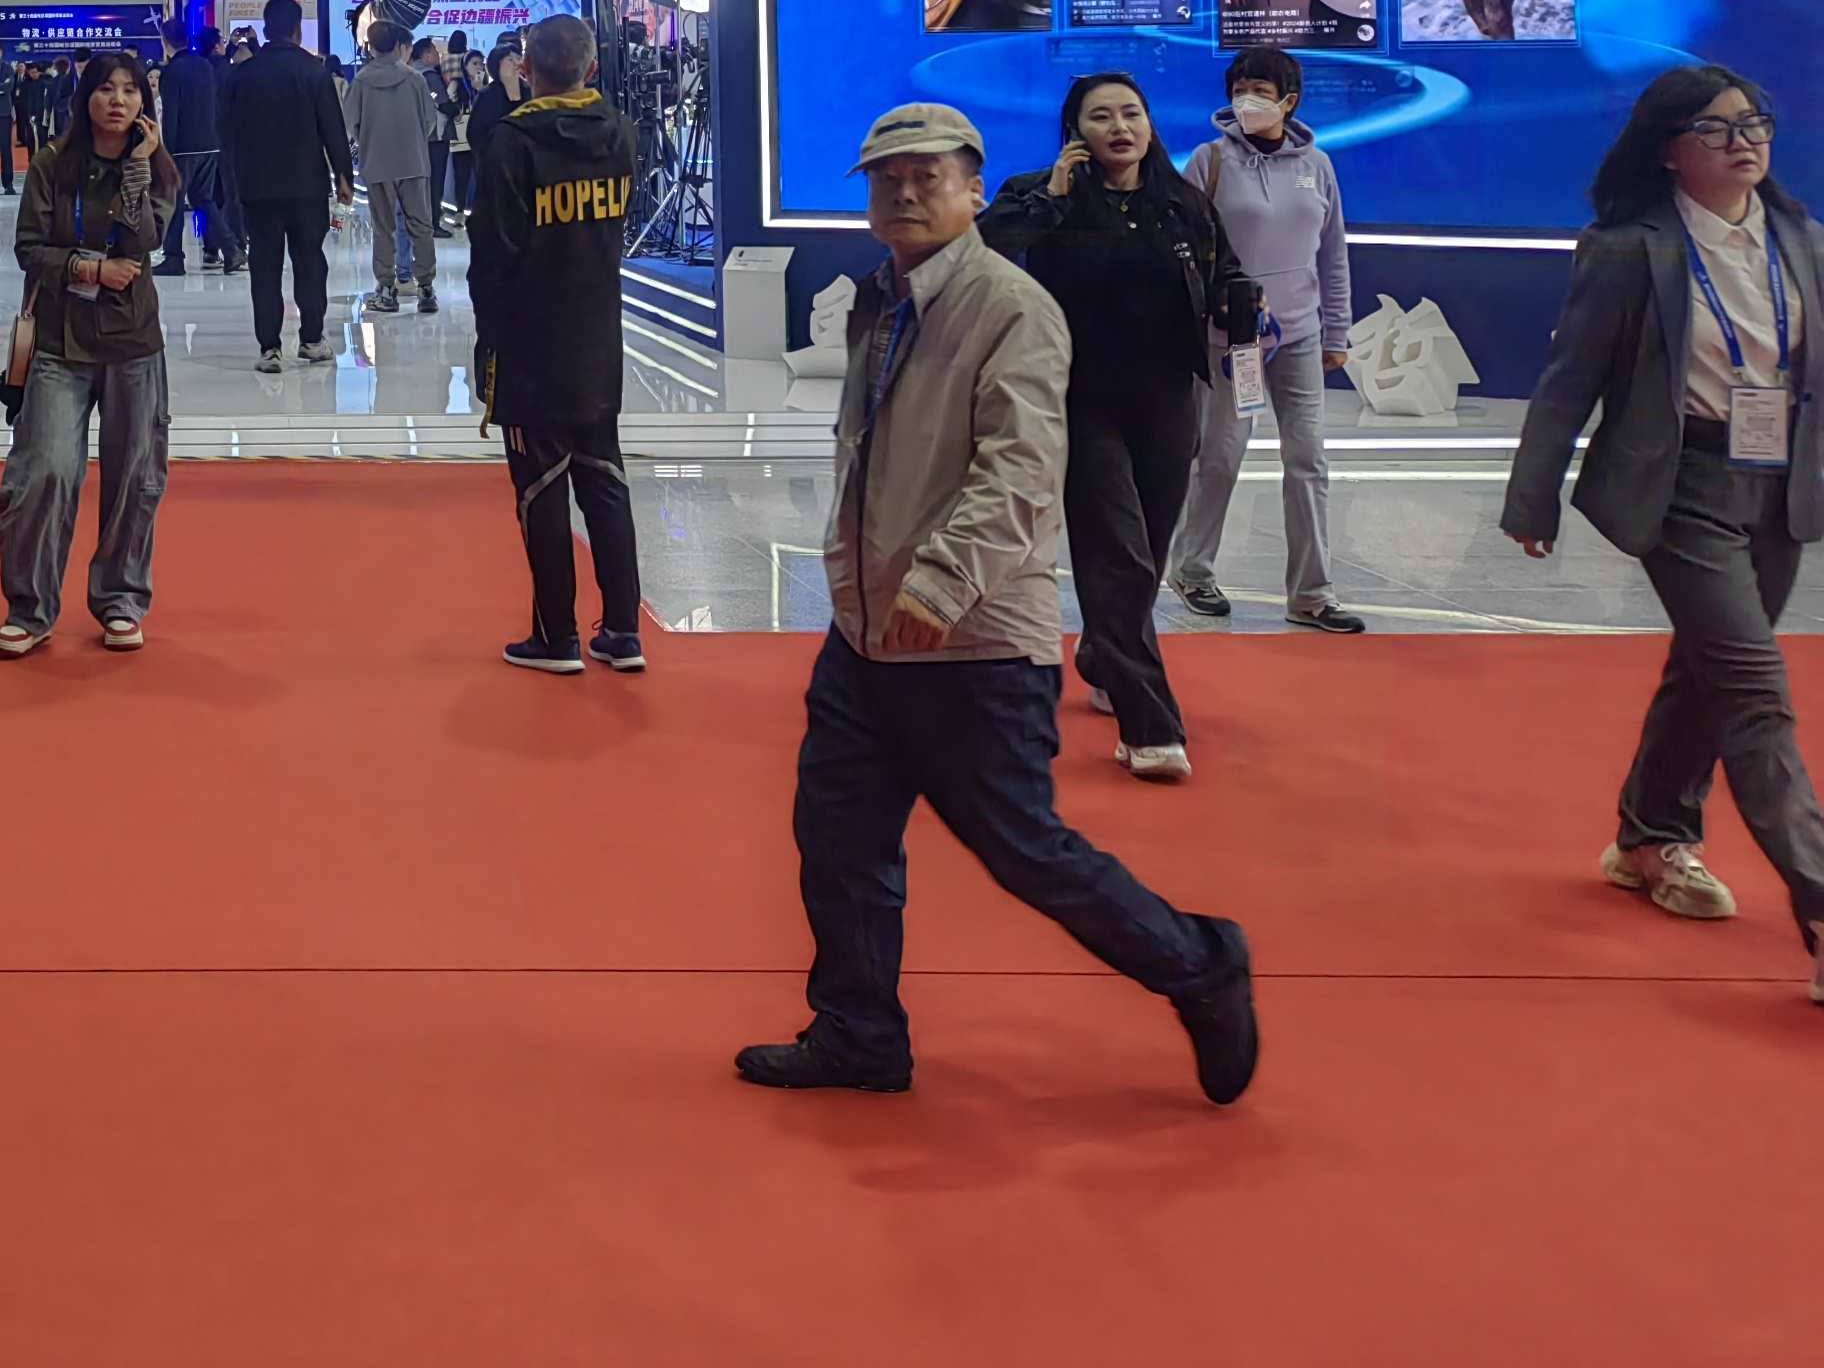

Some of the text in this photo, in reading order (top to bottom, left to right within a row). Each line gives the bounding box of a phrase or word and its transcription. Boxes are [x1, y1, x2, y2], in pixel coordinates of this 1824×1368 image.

[427, 8, 529, 25] 合促边疆振兴
